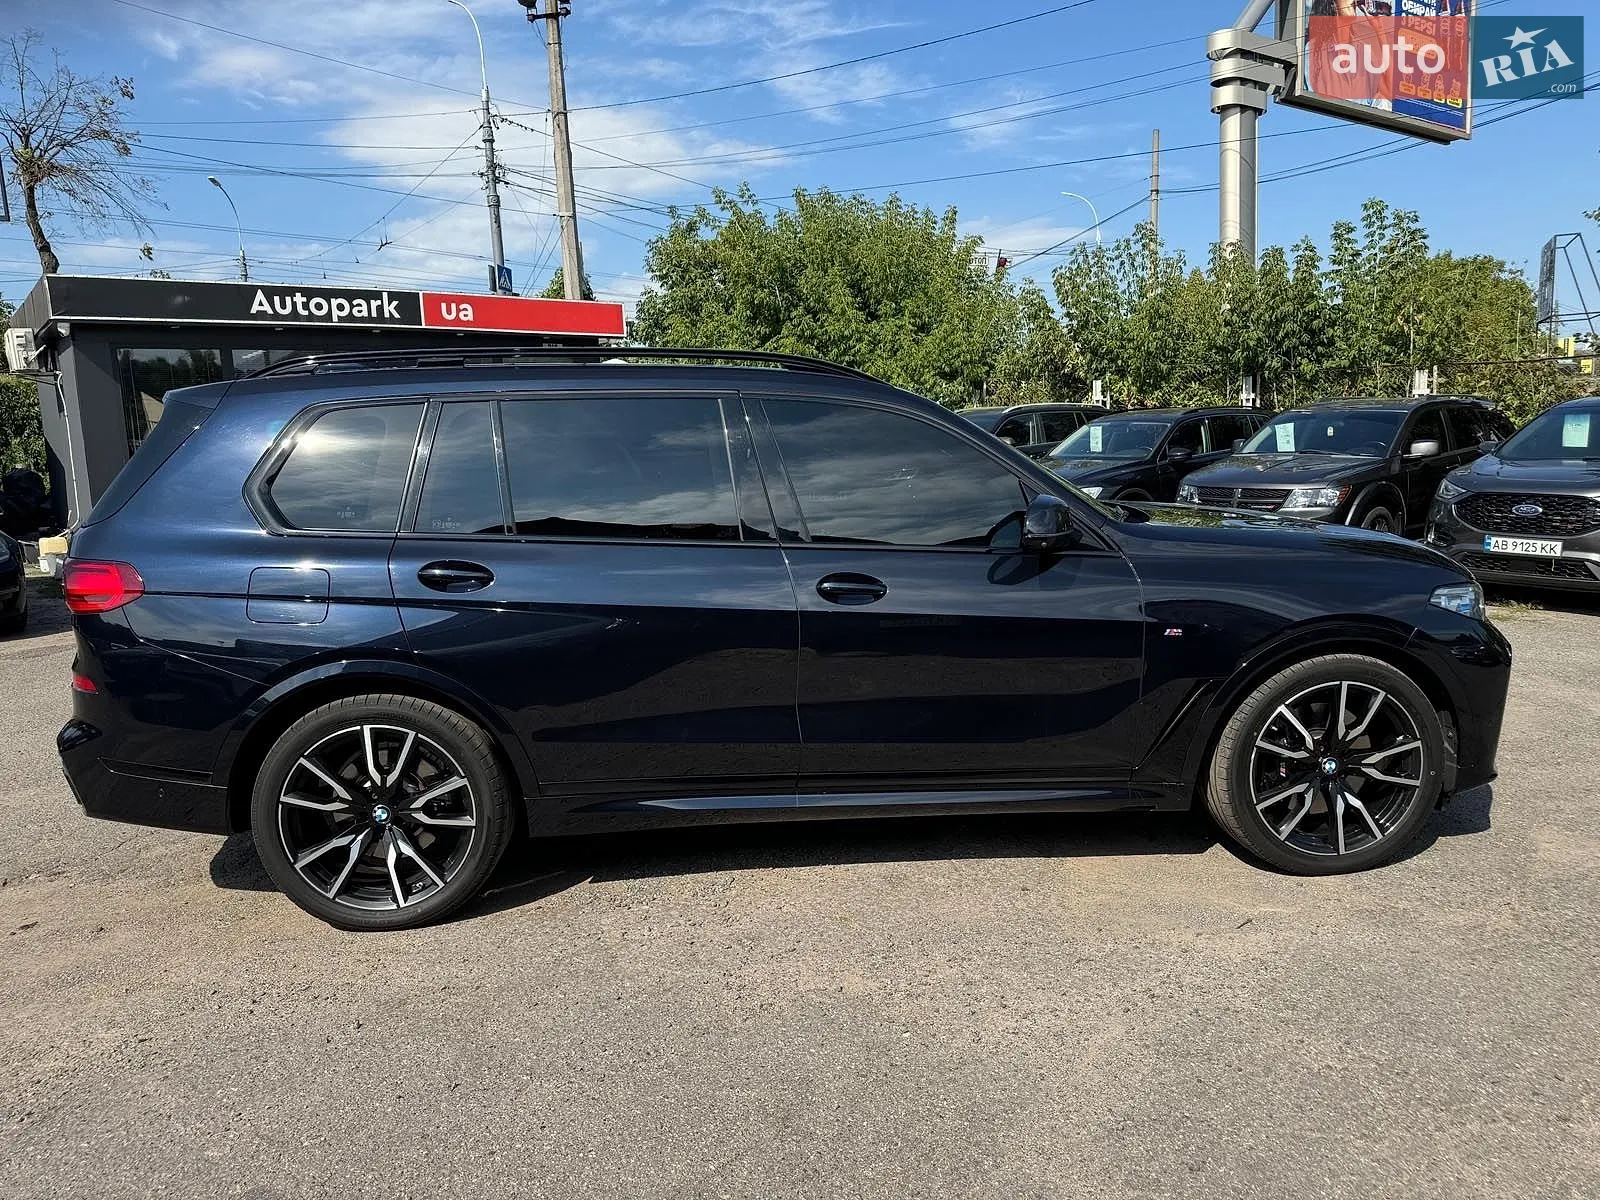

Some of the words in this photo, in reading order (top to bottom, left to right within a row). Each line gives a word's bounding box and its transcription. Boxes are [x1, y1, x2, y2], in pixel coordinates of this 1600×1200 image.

[1407, 15, 1437, 36] PEPSI
[249, 288, 401, 322] Autopark
[440, 299, 474, 322] ua
[1492, 539, 1509, 550] AB
[1511, 540, 1538, 553] 9125
[1540, 543, 1558, 555] KK
